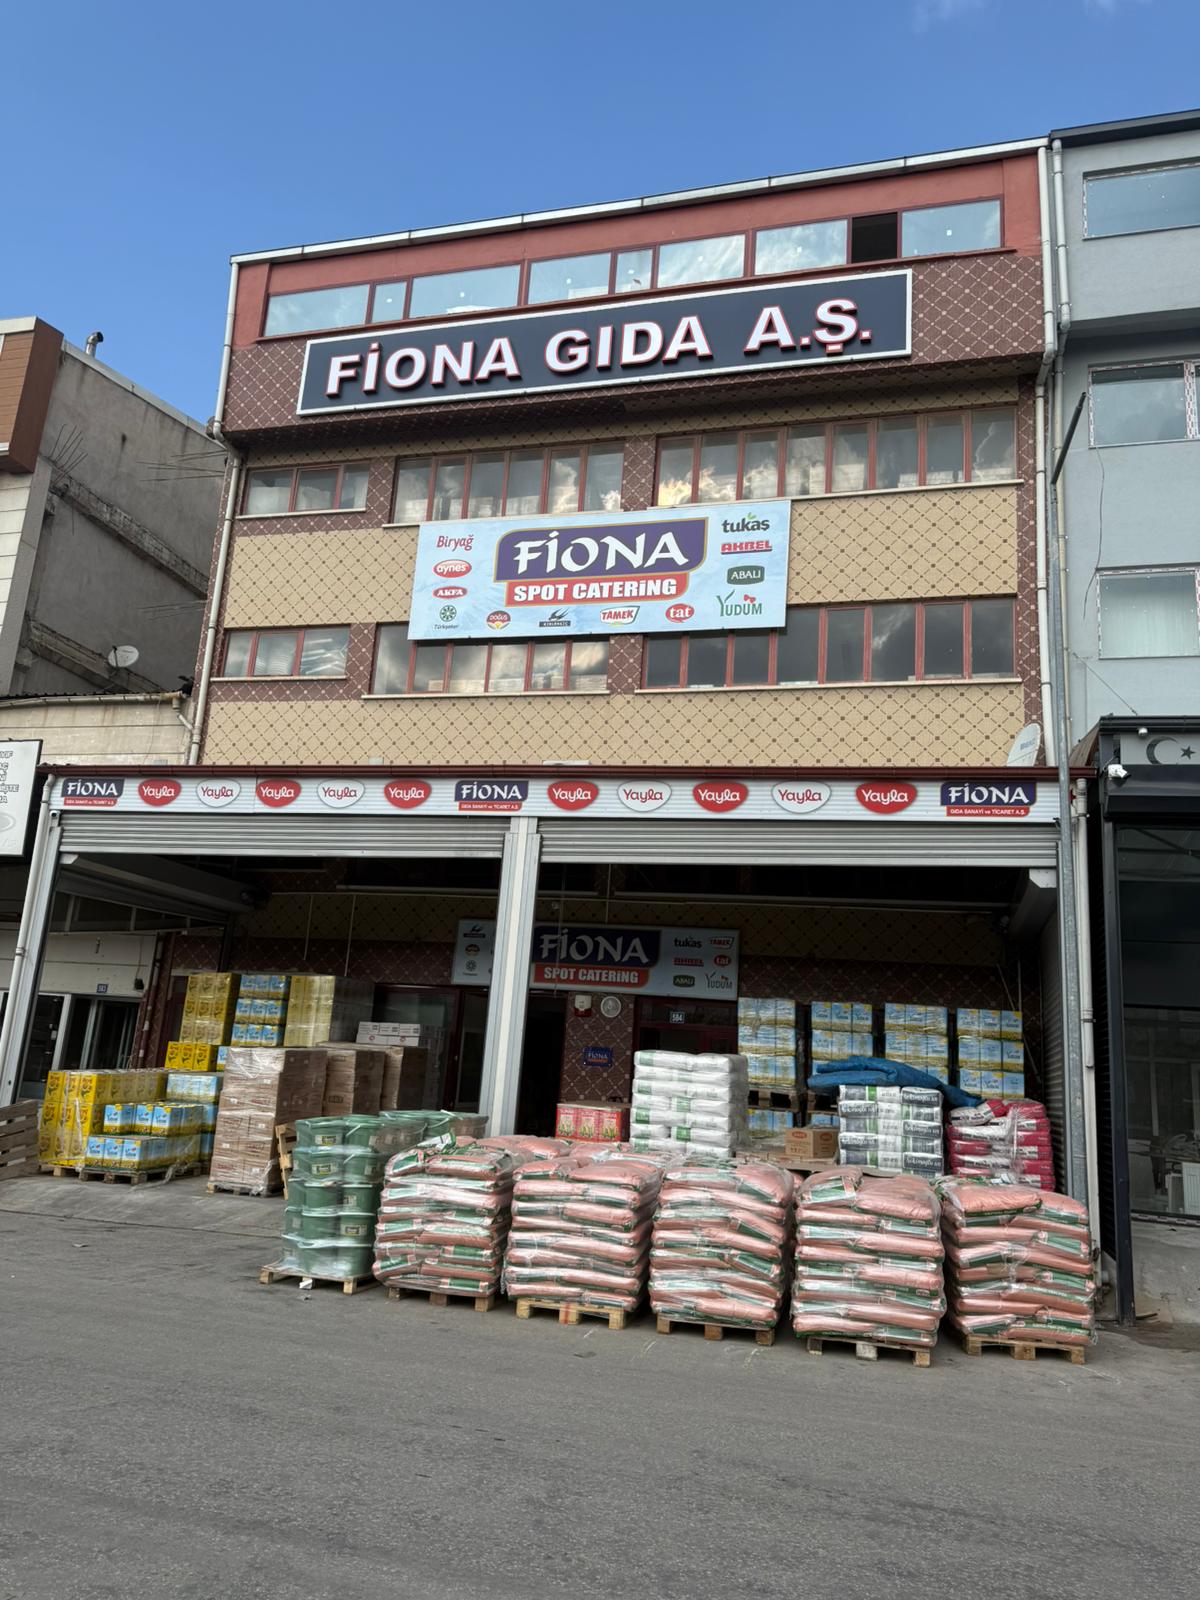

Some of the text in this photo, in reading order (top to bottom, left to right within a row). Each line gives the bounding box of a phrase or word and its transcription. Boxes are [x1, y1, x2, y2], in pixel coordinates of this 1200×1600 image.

[325, 298, 873, 396] FİONA GIDA A.Ş.
[436, 534, 474, 552] Biryağ
[513, 530, 689, 574] FİONA
[436, 563, 467, 575] aynes
[731, 569, 761, 580] ABALI
[514, 584, 568, 602] SPOT
[601, 609, 634, 619] TAMEK
[669, 606, 691, 618] tat
[67, 779, 118, 796] FİONA
[142, 786, 175, 798] Yayla
[201, 786, 233, 799] Yayla
[260, 786, 294, 799] Yayla
[322, 787, 357, 800] Yayla
[389, 787, 424, 800] Yayla
[461, 781, 522, 799] FİONA
[948, 783, 1029, 804] FİONA
[552, 788, 591, 802] Yayla
[623, 788, 663, 803] Yayla
[698, 789, 740, 803] Yayla
[778, 789, 822, 804] Yayla
[862, 789, 908, 805] Yayla
[539, 928, 649, 964] FİONA
[544, 967, 576, 980] SPOT
